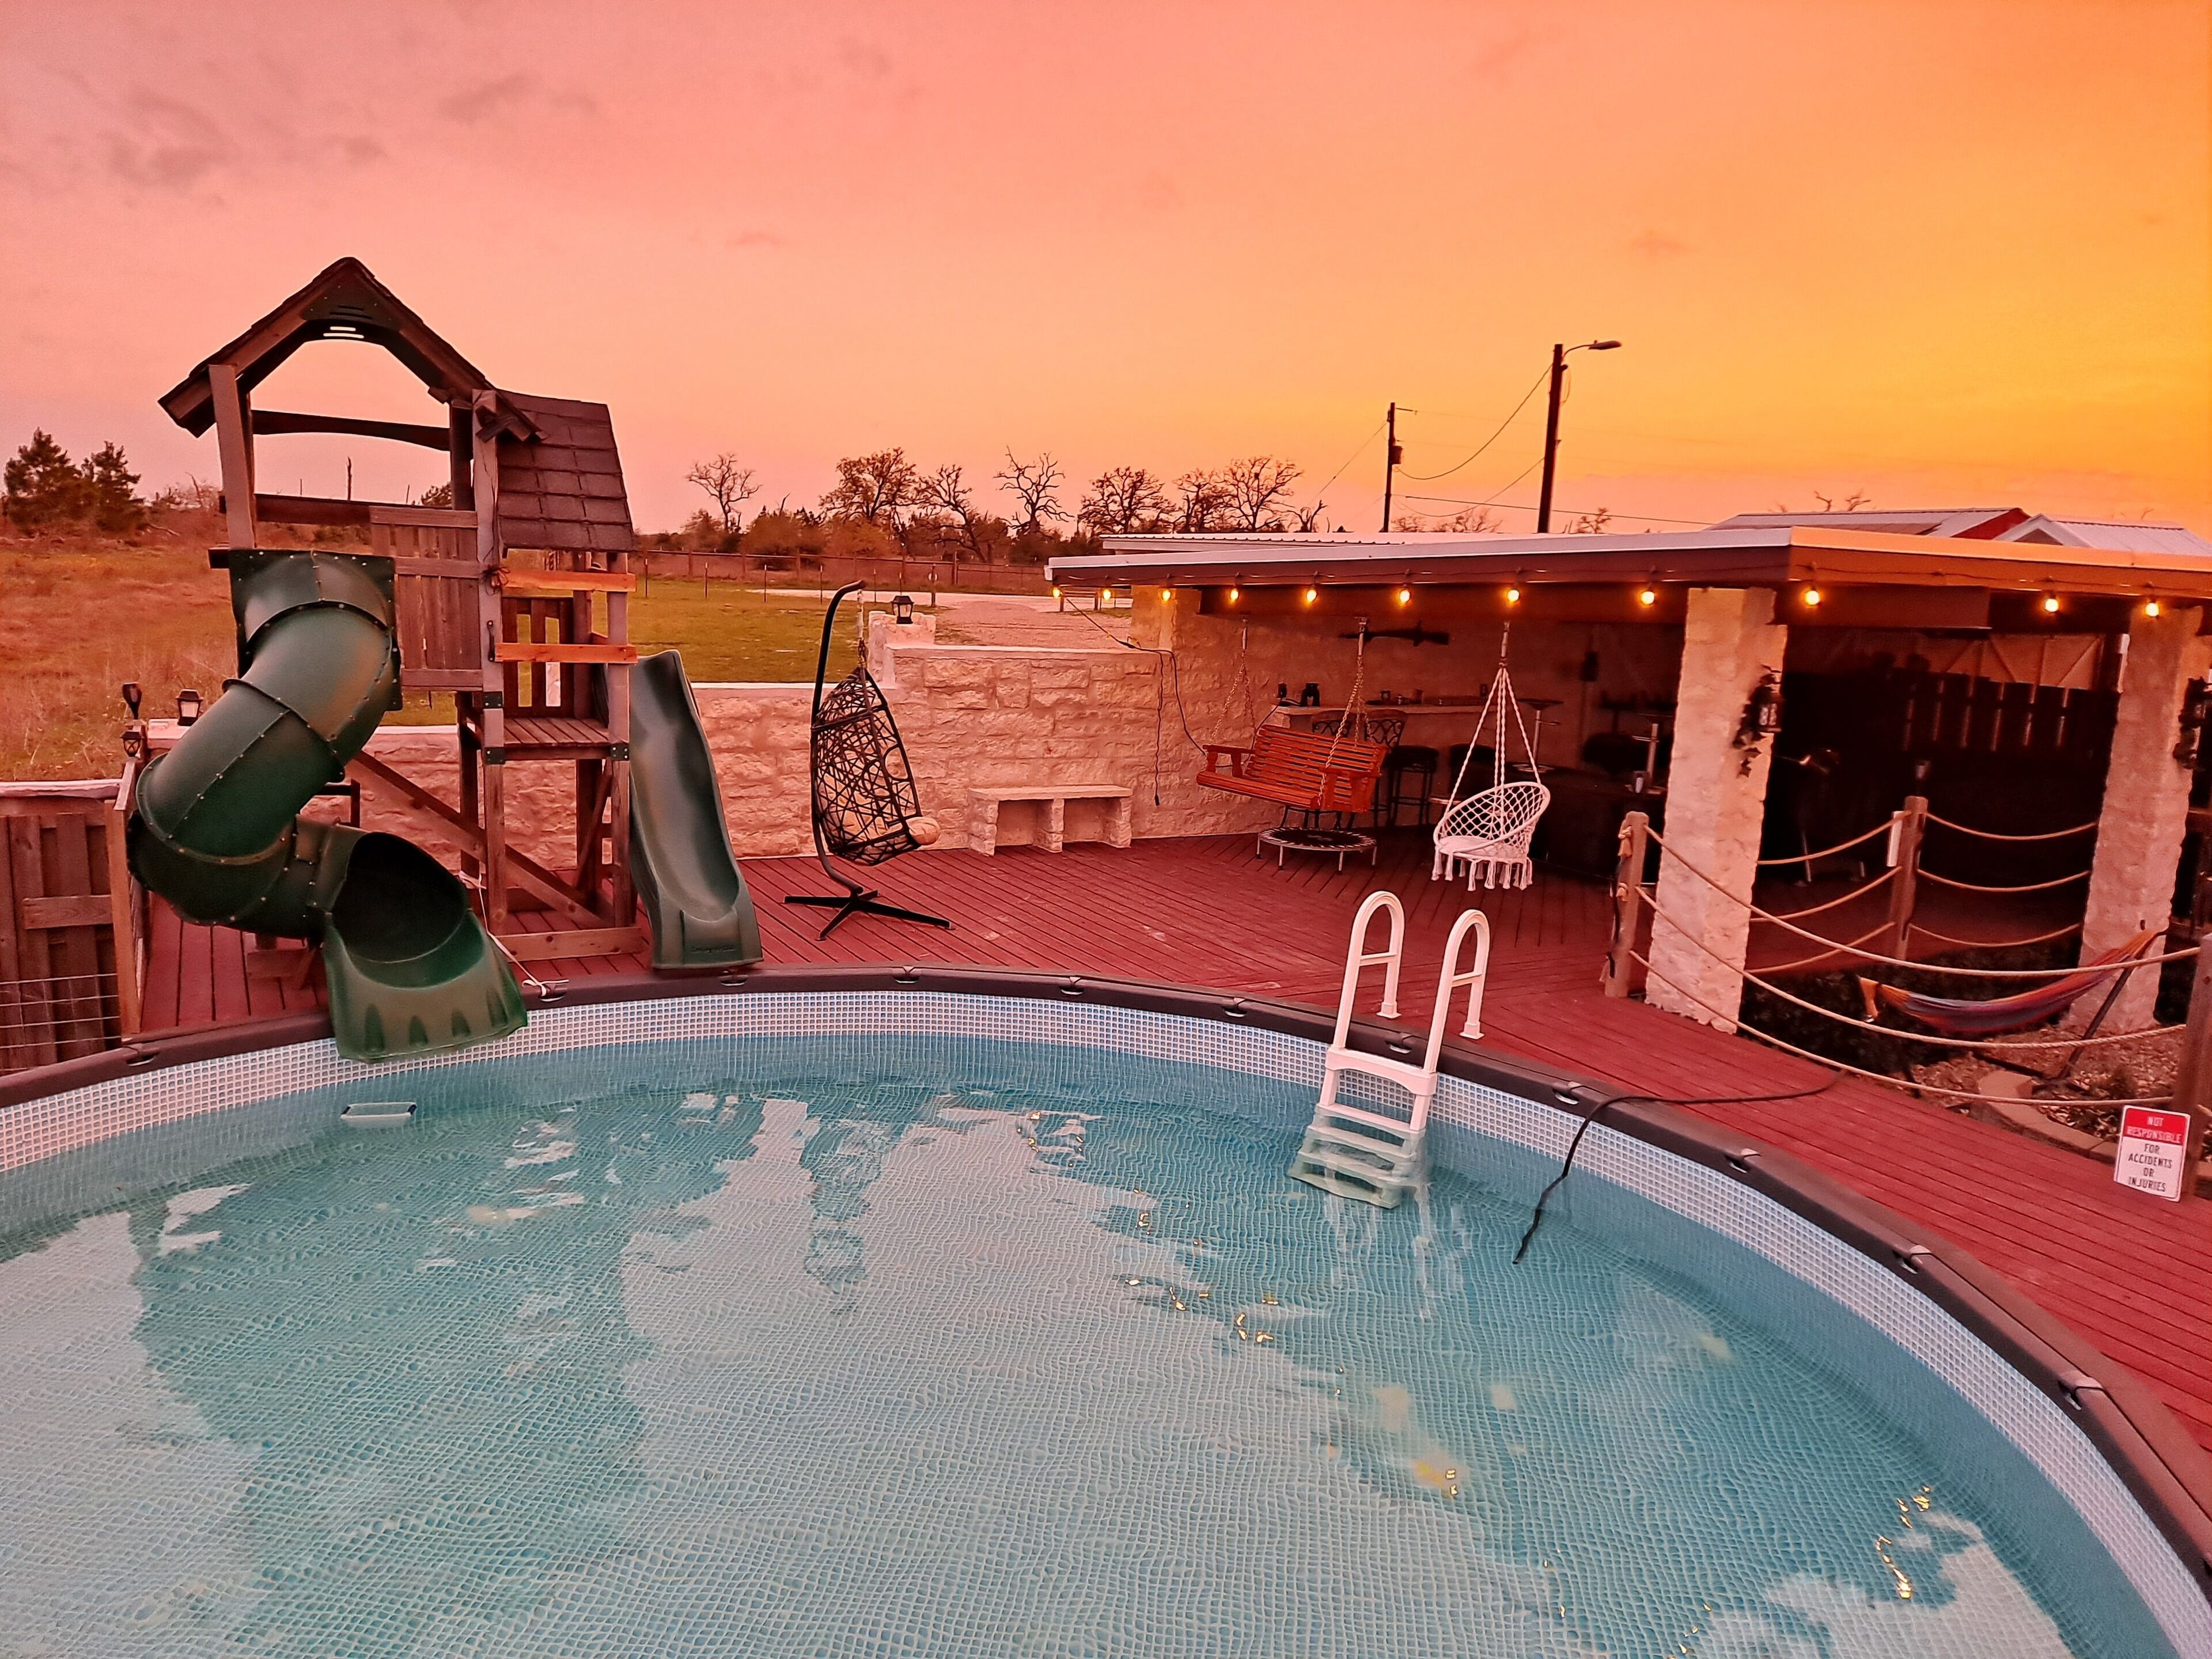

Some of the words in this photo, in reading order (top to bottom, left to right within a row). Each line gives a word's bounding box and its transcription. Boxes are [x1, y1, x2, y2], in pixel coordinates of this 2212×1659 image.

[2147, 1116, 2164, 1126] NOT
[2127, 1126, 2181, 1143] RESPONSIBLE
[2144, 1143, 2160, 1153] FOR
[2128, 1153, 2173, 1169] ACCIDENTS
[2143, 1167, 2154, 1177] OR
[2128, 1176, 2166, 1192] INJURIES
